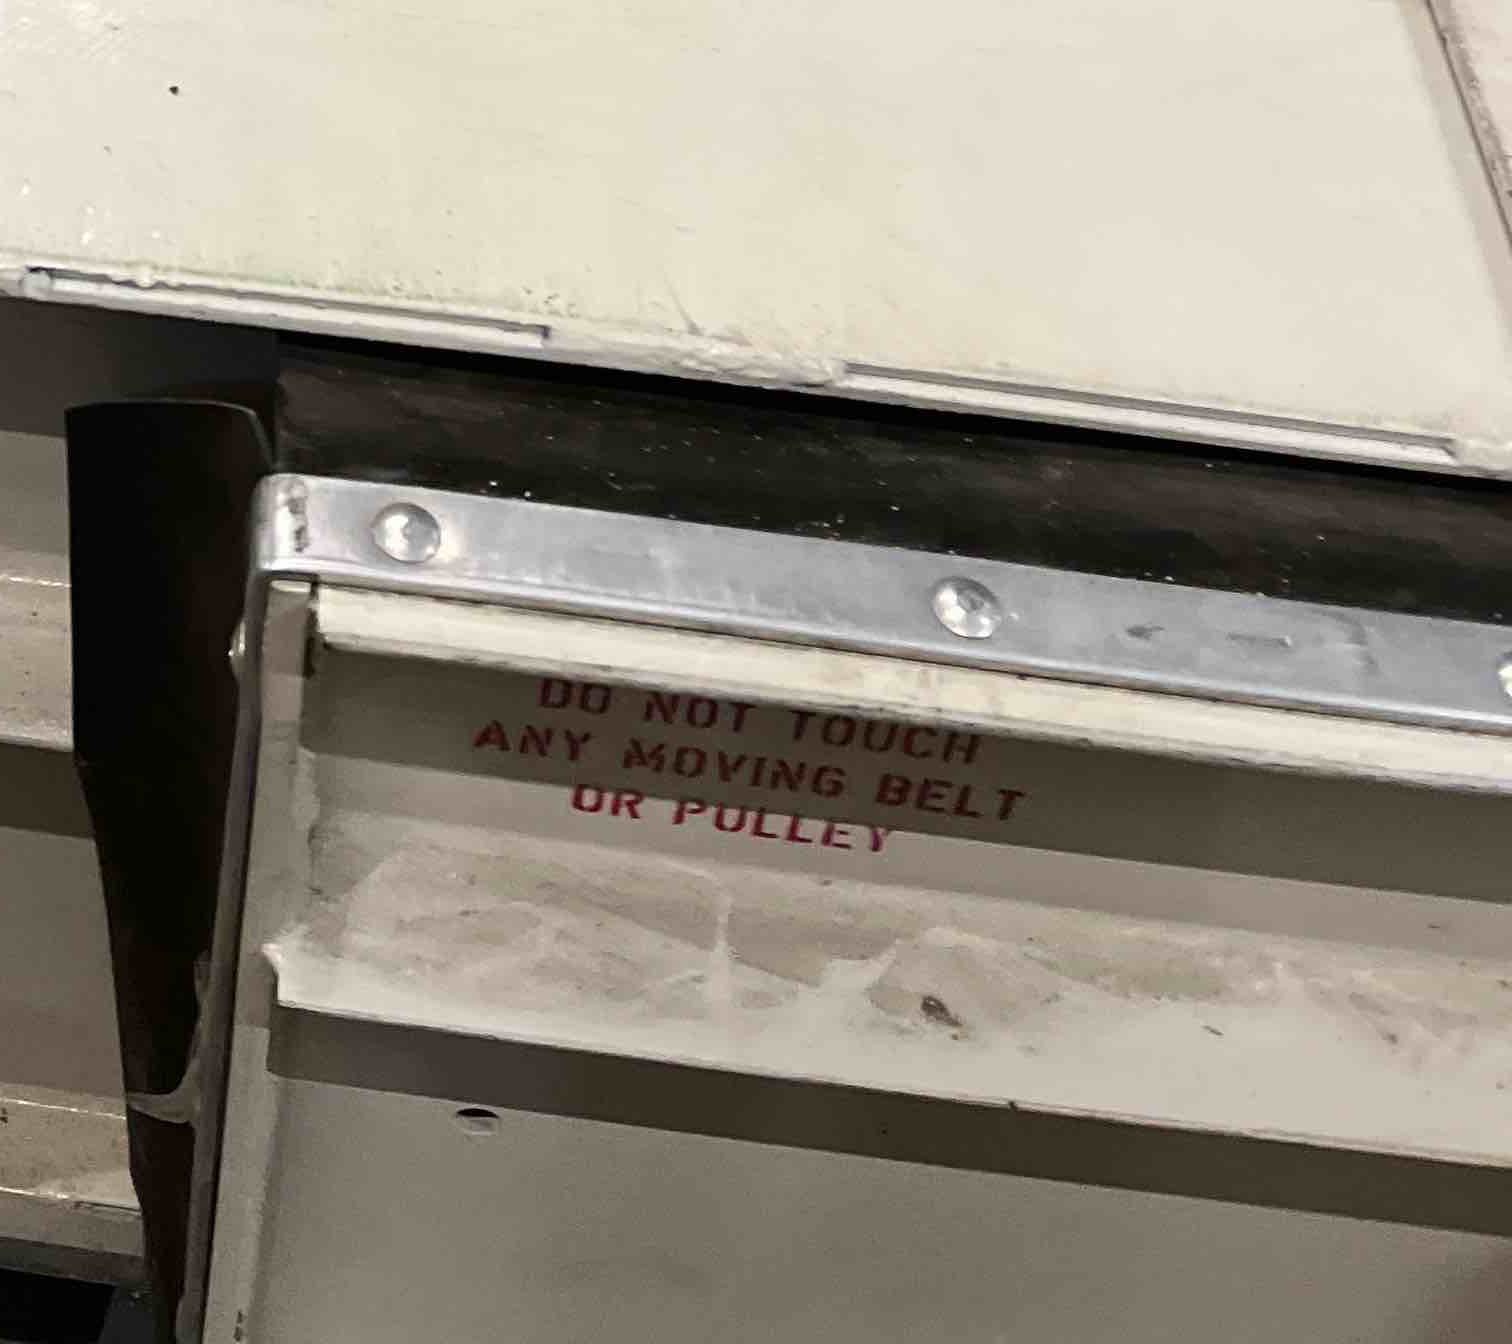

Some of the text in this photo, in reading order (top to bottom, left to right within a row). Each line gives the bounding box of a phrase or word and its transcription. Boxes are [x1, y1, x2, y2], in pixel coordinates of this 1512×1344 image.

[536, 676, 984, 766] DO NOT TOUCH
[472, 718, 1028, 824] ANY MOVING BELT
[568, 781, 899, 855] OR PULLEY
